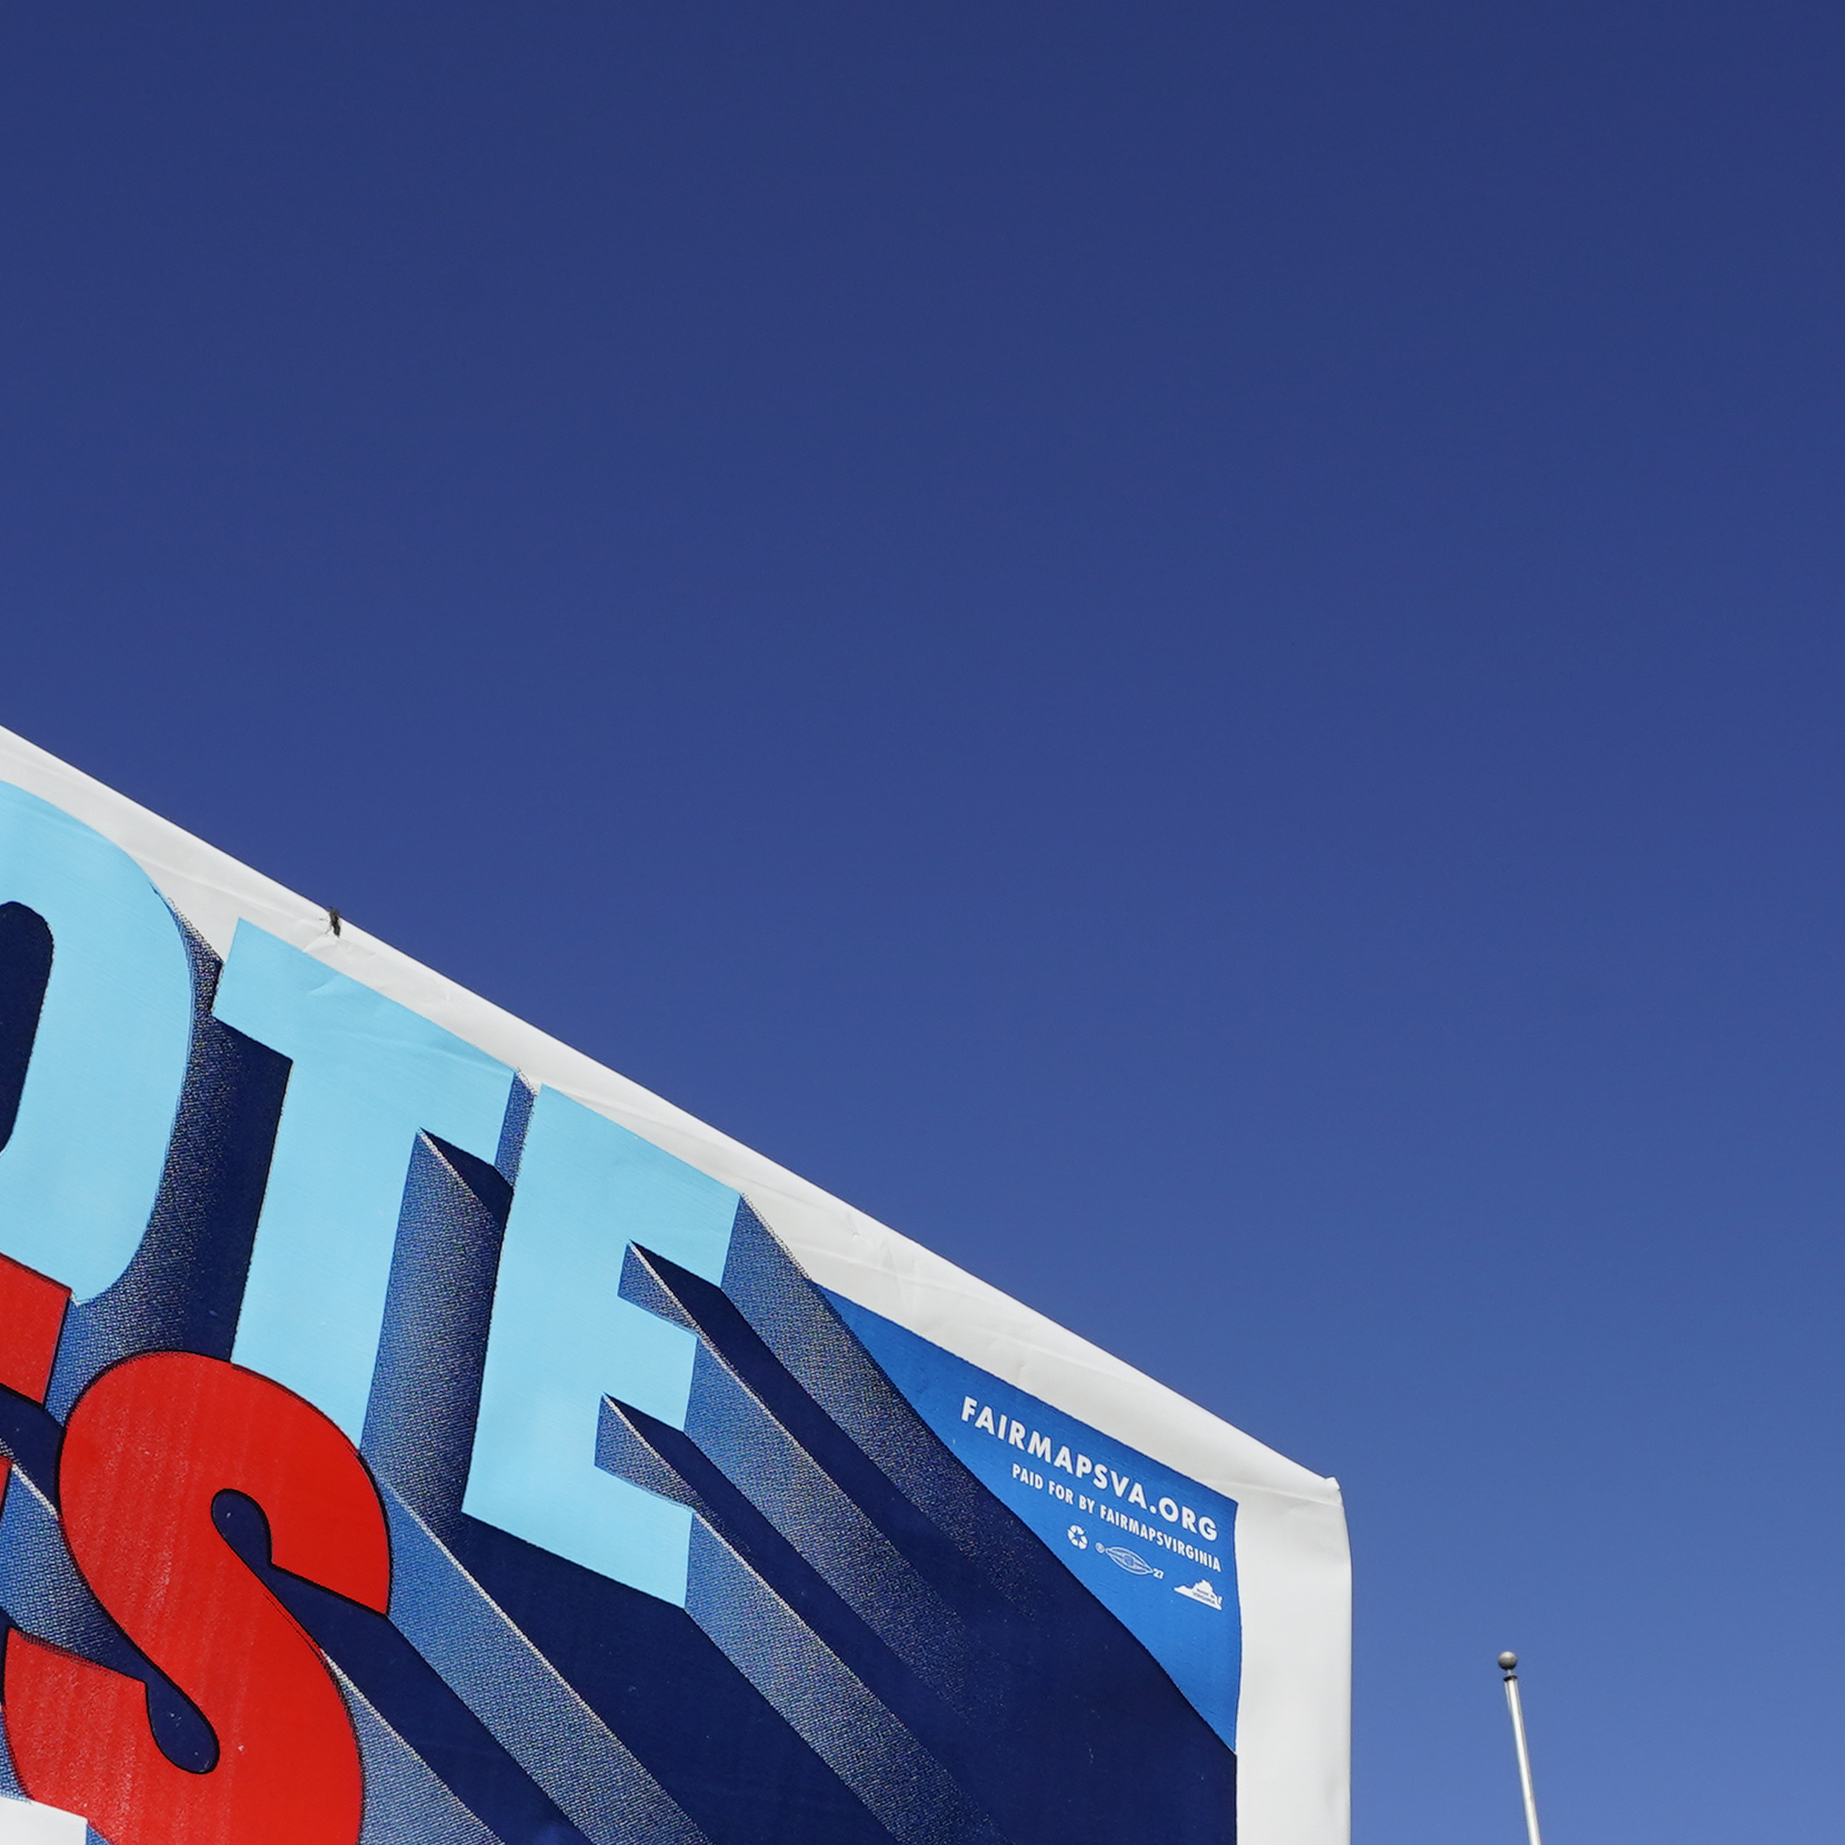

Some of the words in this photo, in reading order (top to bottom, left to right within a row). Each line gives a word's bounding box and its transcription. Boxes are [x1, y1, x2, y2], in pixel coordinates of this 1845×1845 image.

[961, 1396, 1218, 1541] FAIRMAPSVA.ORG
[1012, 1463, 1043, 1491] PAID
[1048, 1480, 1074, 1505] FOR
[1078, 1494, 1096, 1515] BY
[1100, 1505, 1222, 1573] FAIRMAPSVIRGINIA
